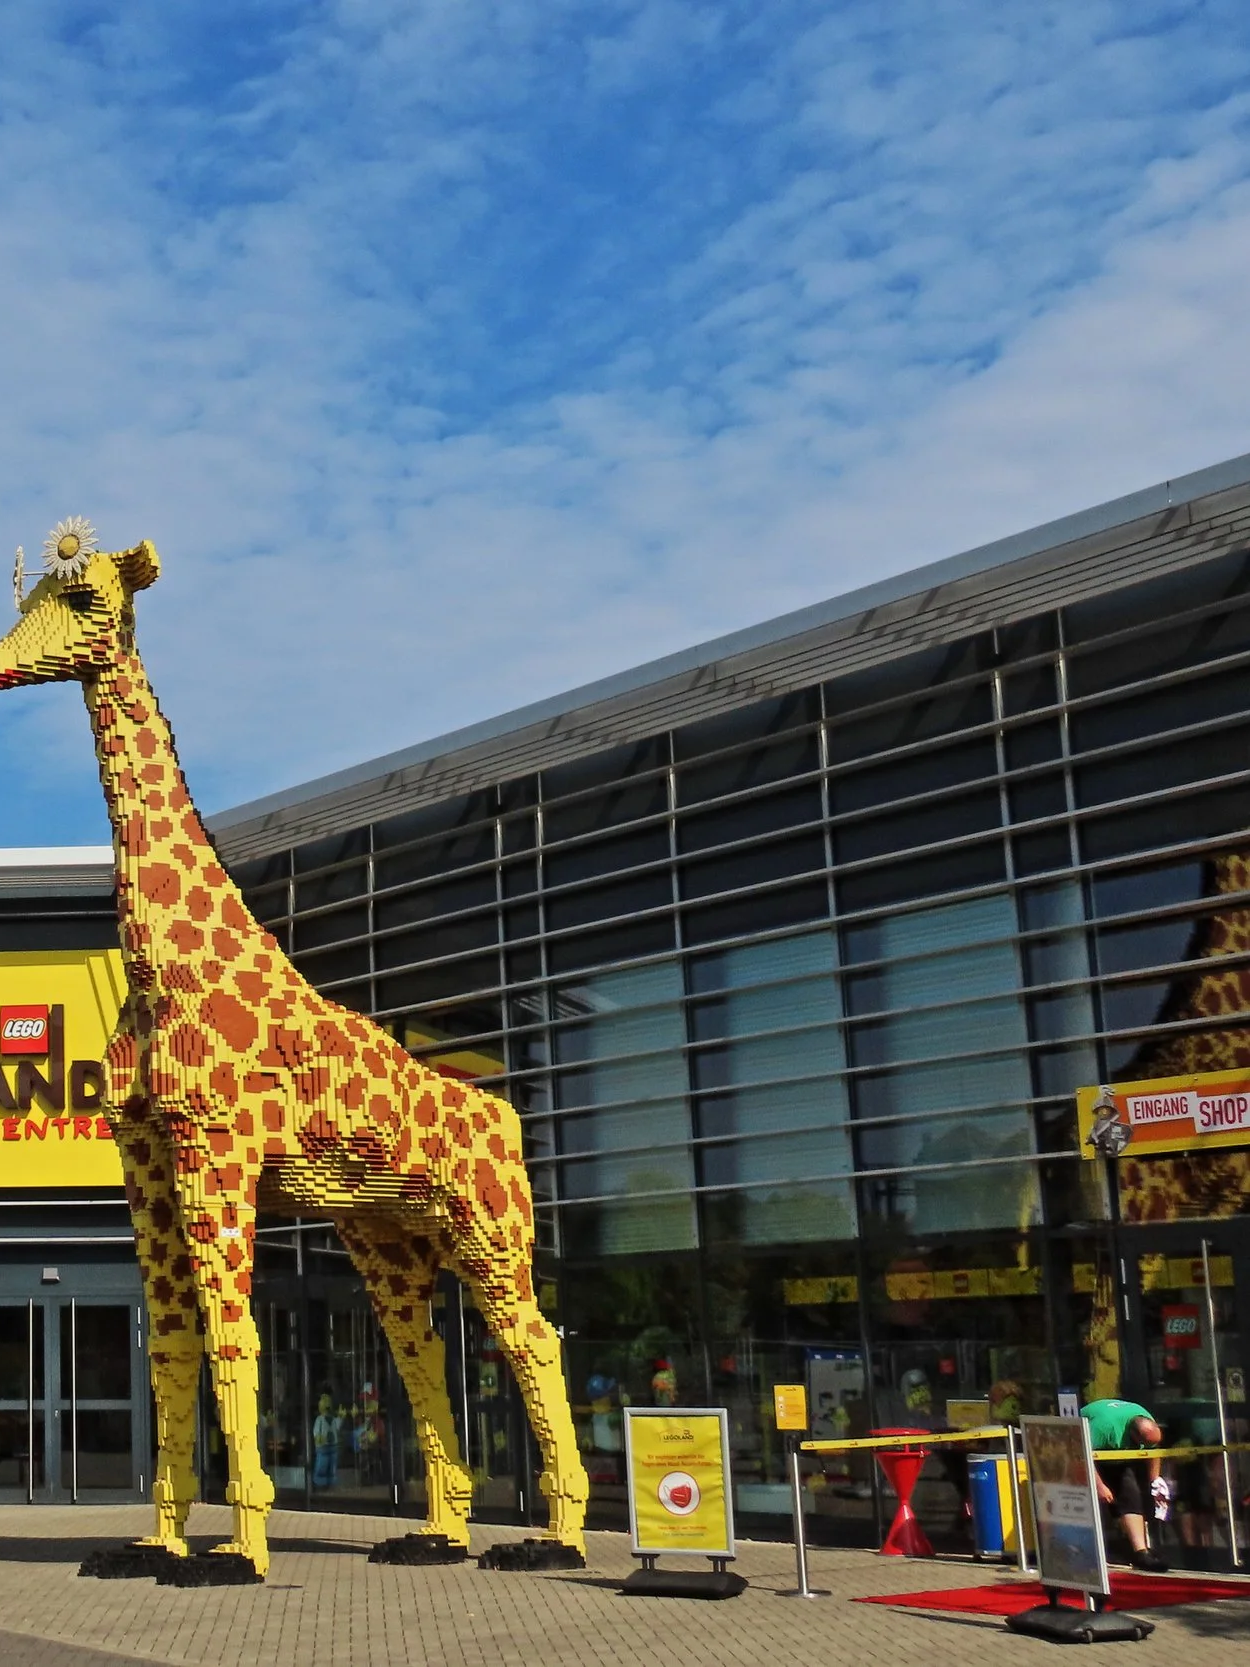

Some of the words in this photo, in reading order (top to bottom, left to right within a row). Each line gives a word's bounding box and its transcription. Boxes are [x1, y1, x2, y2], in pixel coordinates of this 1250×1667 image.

[2, 1018, 46, 1039] LEGO
[1134, 1096, 1189, 1120] EINGANG
[1200, 1096, 1248, 1127] SHOP
[1166, 1318, 1196, 1333] LEGO
